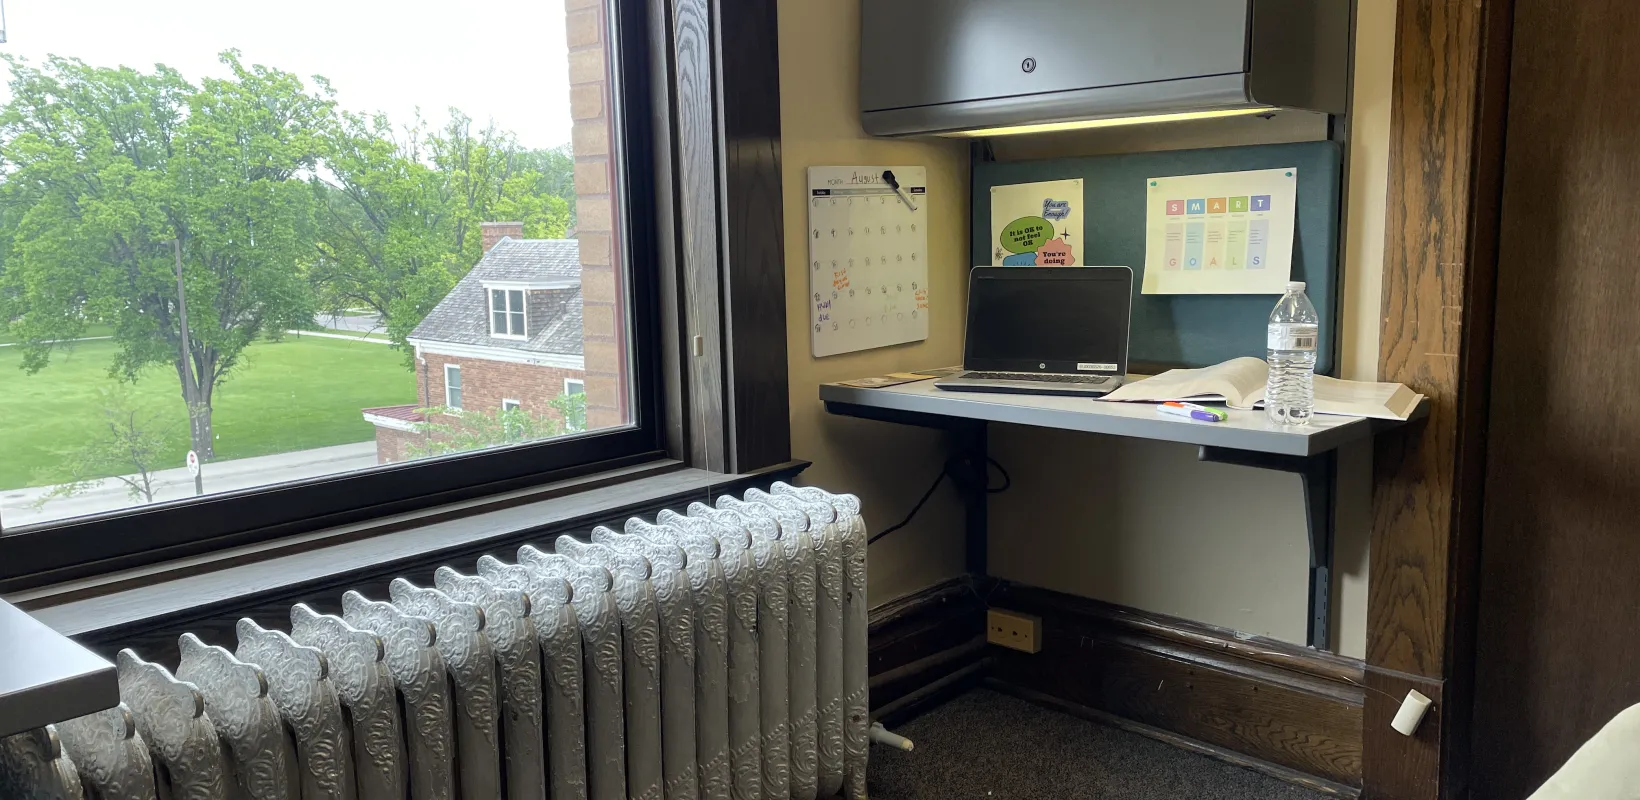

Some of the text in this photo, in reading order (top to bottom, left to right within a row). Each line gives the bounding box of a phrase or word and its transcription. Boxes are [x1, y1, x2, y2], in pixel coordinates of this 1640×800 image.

[851, 171, 879, 185] August
[1045, 200, 1056, 209] You
[1044, 209, 1068, 219] Enough!
